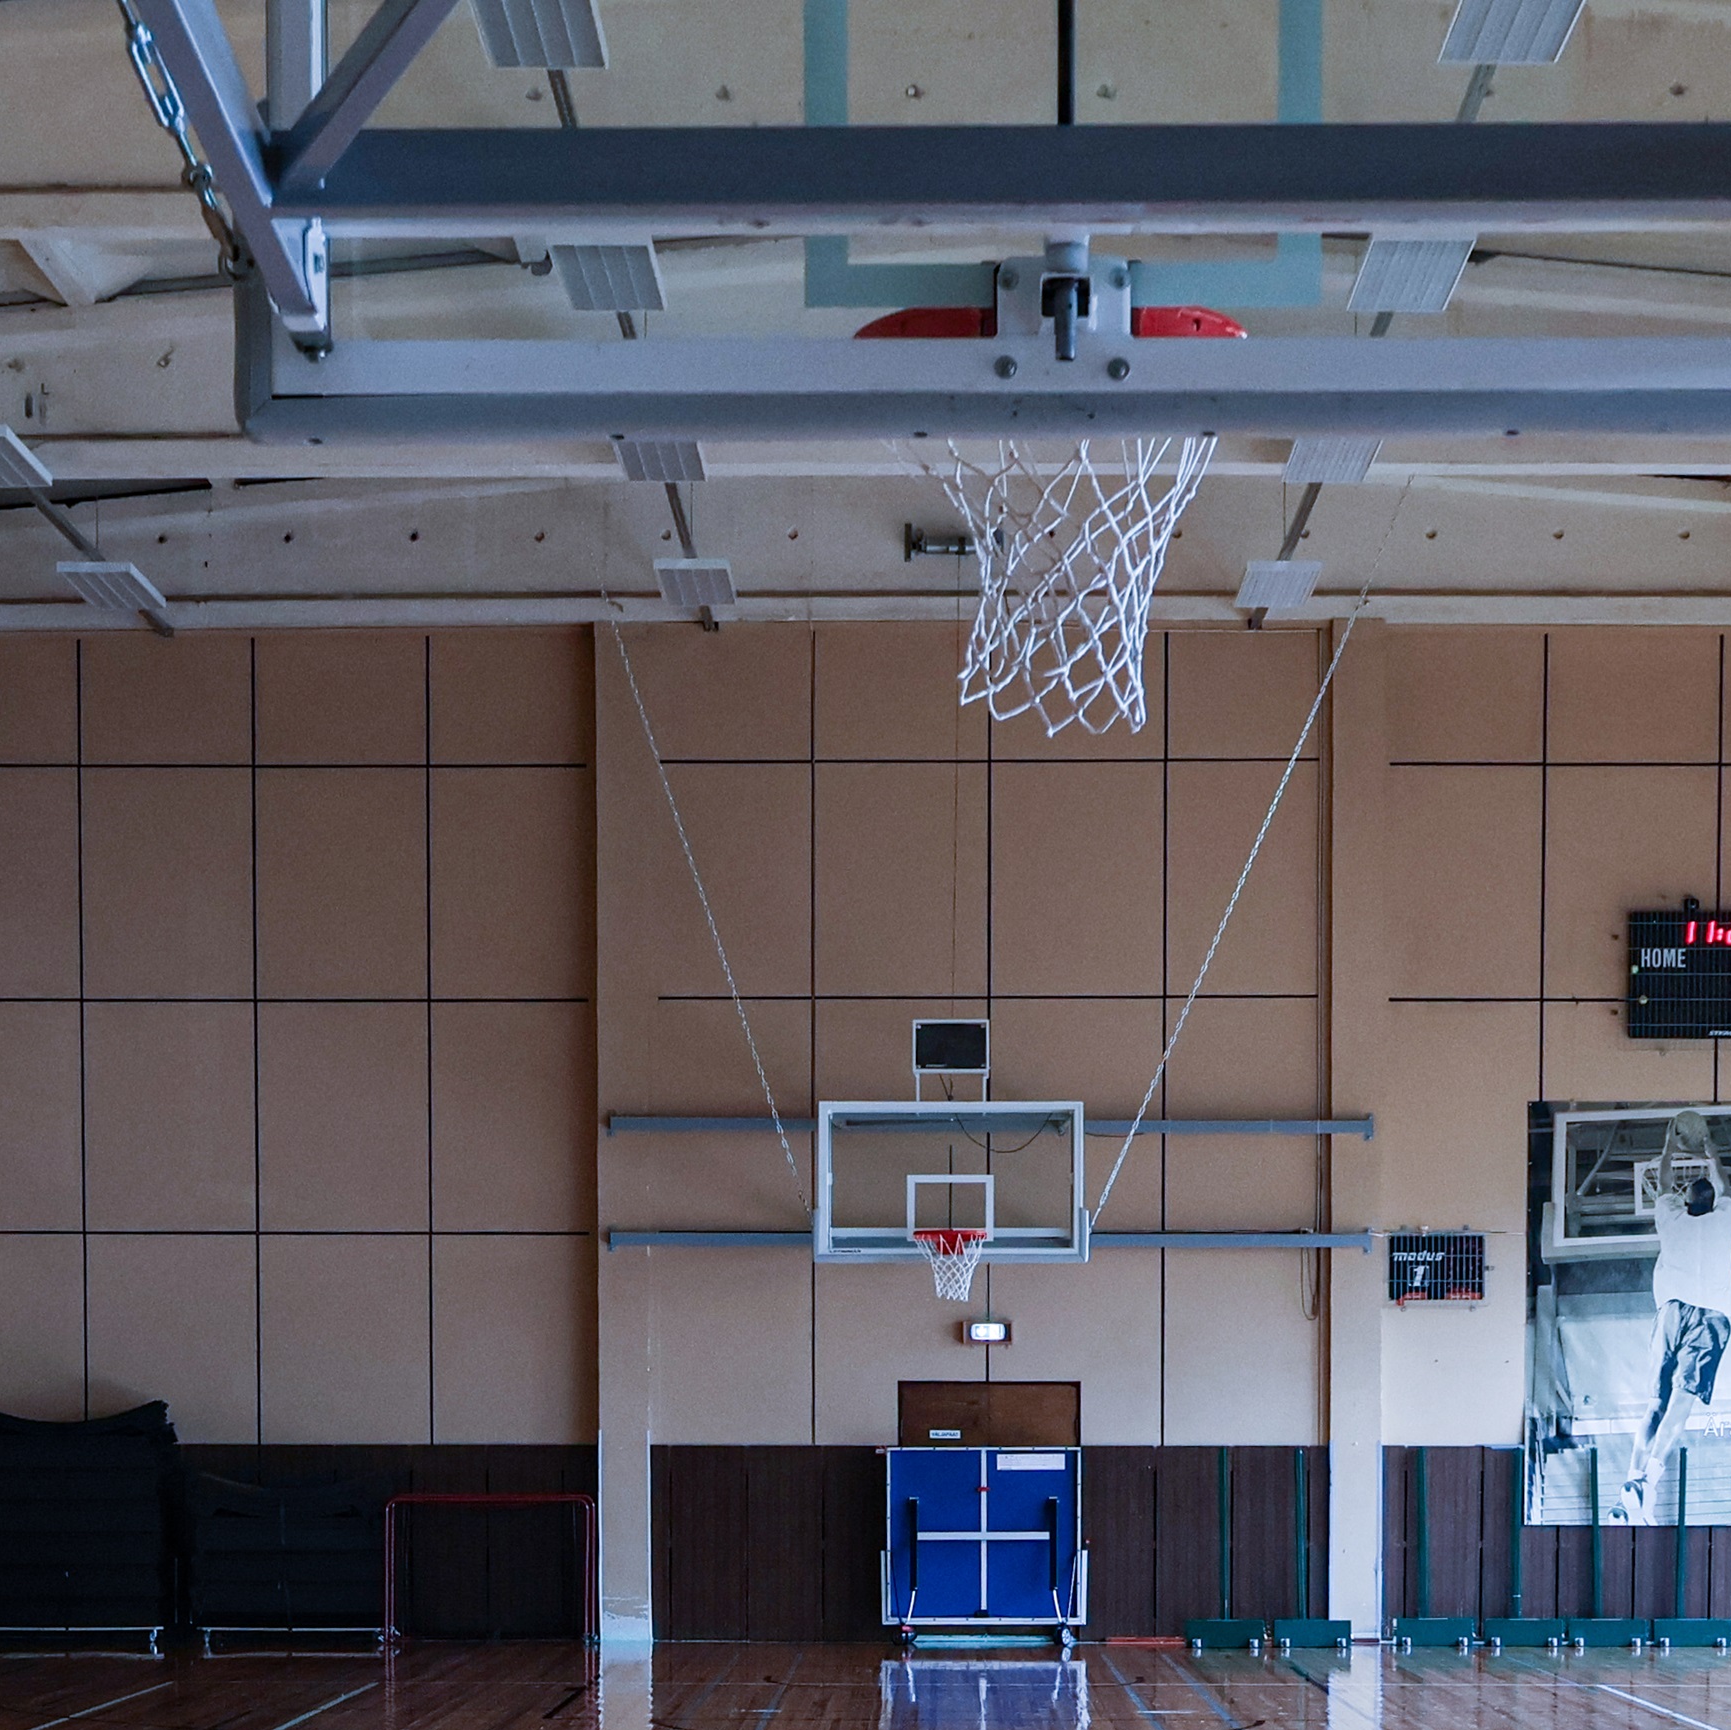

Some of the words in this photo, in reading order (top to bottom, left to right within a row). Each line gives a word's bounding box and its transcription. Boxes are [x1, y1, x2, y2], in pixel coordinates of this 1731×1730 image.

[1641, 948, 1686, 968] HOME
[1392, 1250, 1445, 1261] modus
[1409, 1265, 1429, 1287] 1
